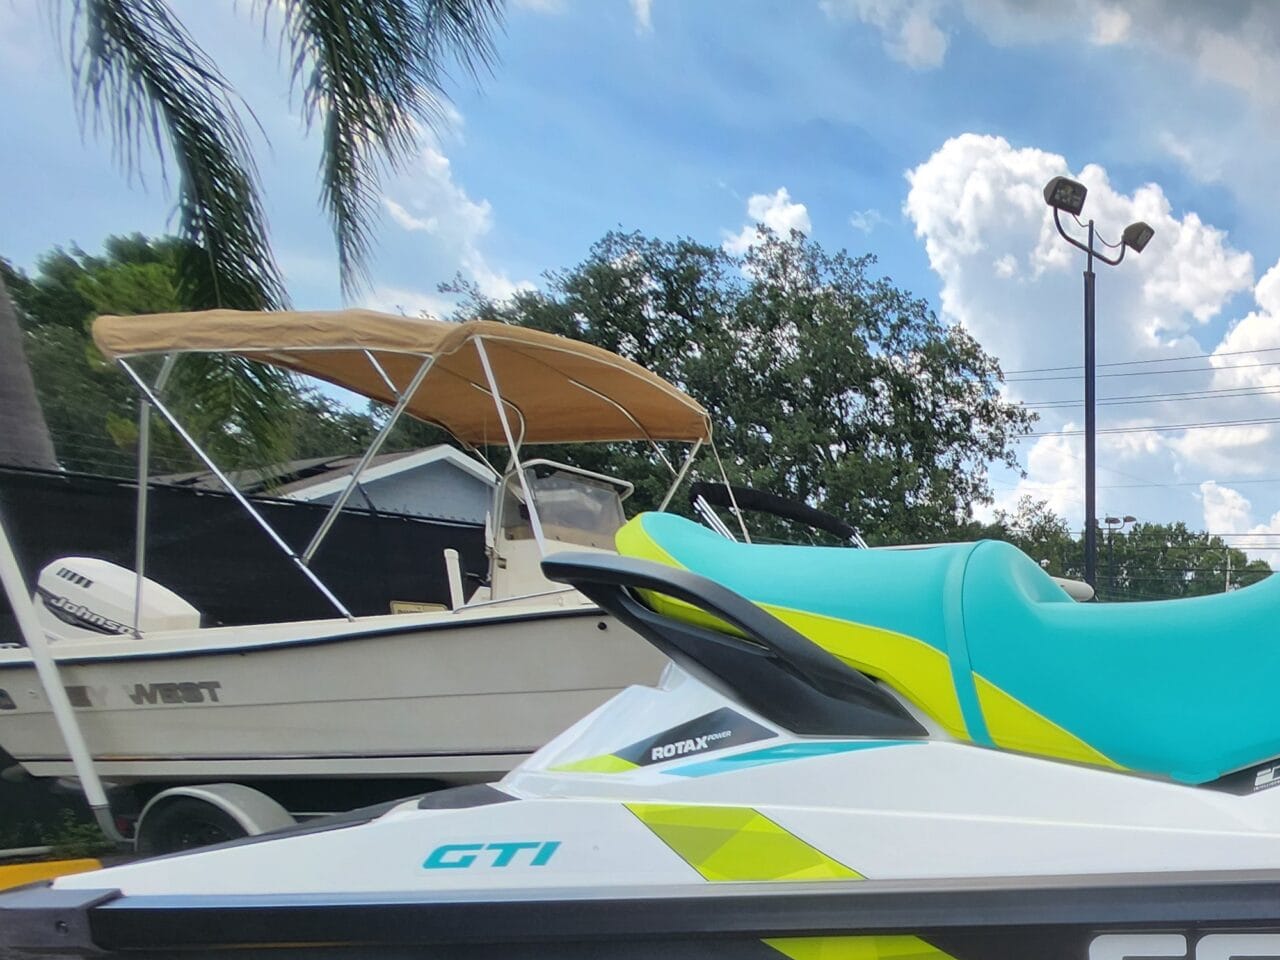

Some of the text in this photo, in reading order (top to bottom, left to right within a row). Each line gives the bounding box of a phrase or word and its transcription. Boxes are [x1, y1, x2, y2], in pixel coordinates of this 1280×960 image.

[50, 594, 144, 636] Johnso
[130, 680, 221, 705] WEST
[651, 730, 732, 761] ROTAX POWER
[422, 841, 562, 870] GTI
